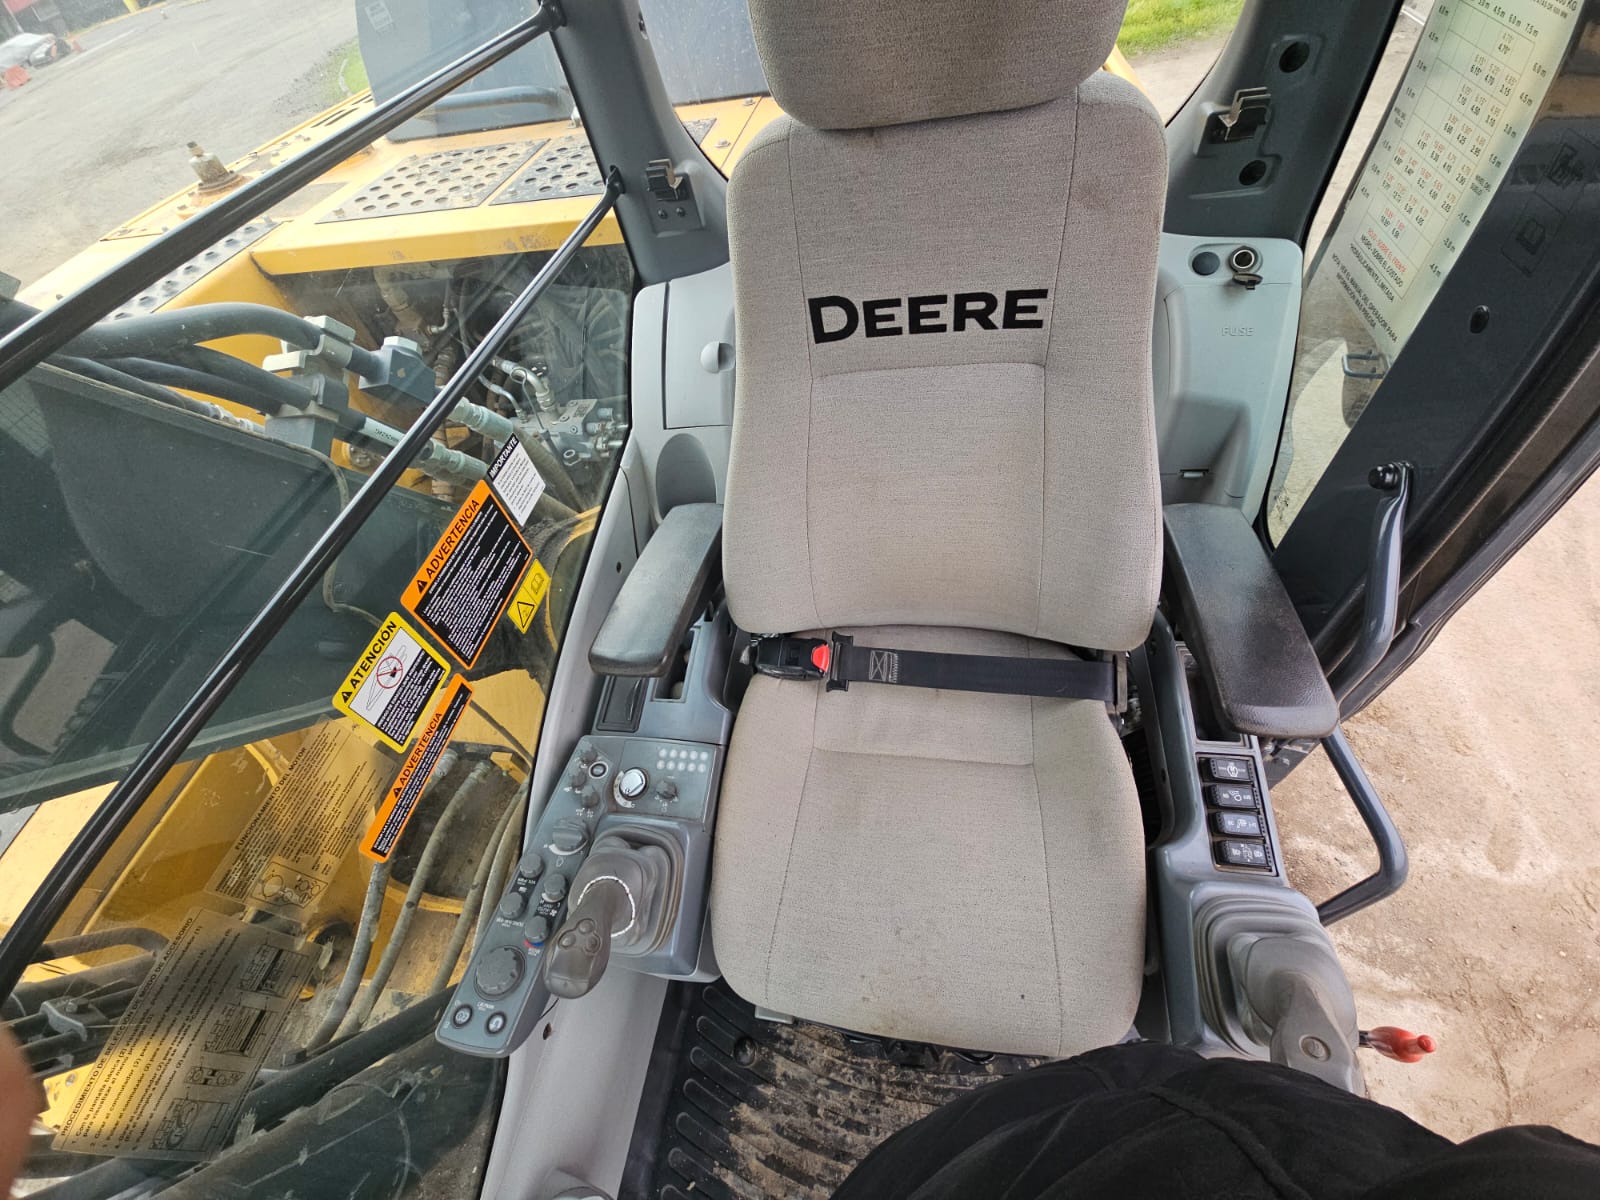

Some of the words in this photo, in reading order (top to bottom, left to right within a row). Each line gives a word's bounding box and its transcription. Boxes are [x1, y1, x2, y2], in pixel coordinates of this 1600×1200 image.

[807, 288, 1049, 344] DEERE
[1221, 327, 1254, 336] FUSE
[489, 436, 518, 479] IMPORTANTE
[426, 499, 480, 579] ADVERTENCIA
[350, 620, 397, 688] ATENCIÓN
[399, 712, 442, 787] ADVERTENCIA
[234, 786, 280, 849] FUNCIONAMIENTO
[277, 772, 290, 785] DEL
[288, 747, 306, 770] MOTOR
[60, 1070, 99, 1135] PROCEDIMIENTO
[96, 1058, 106, 1068] DE
[138, 974, 156, 997] MODO
[154, 961, 164, 971] DE
[162, 917, 192, 960] ACCESORIO
